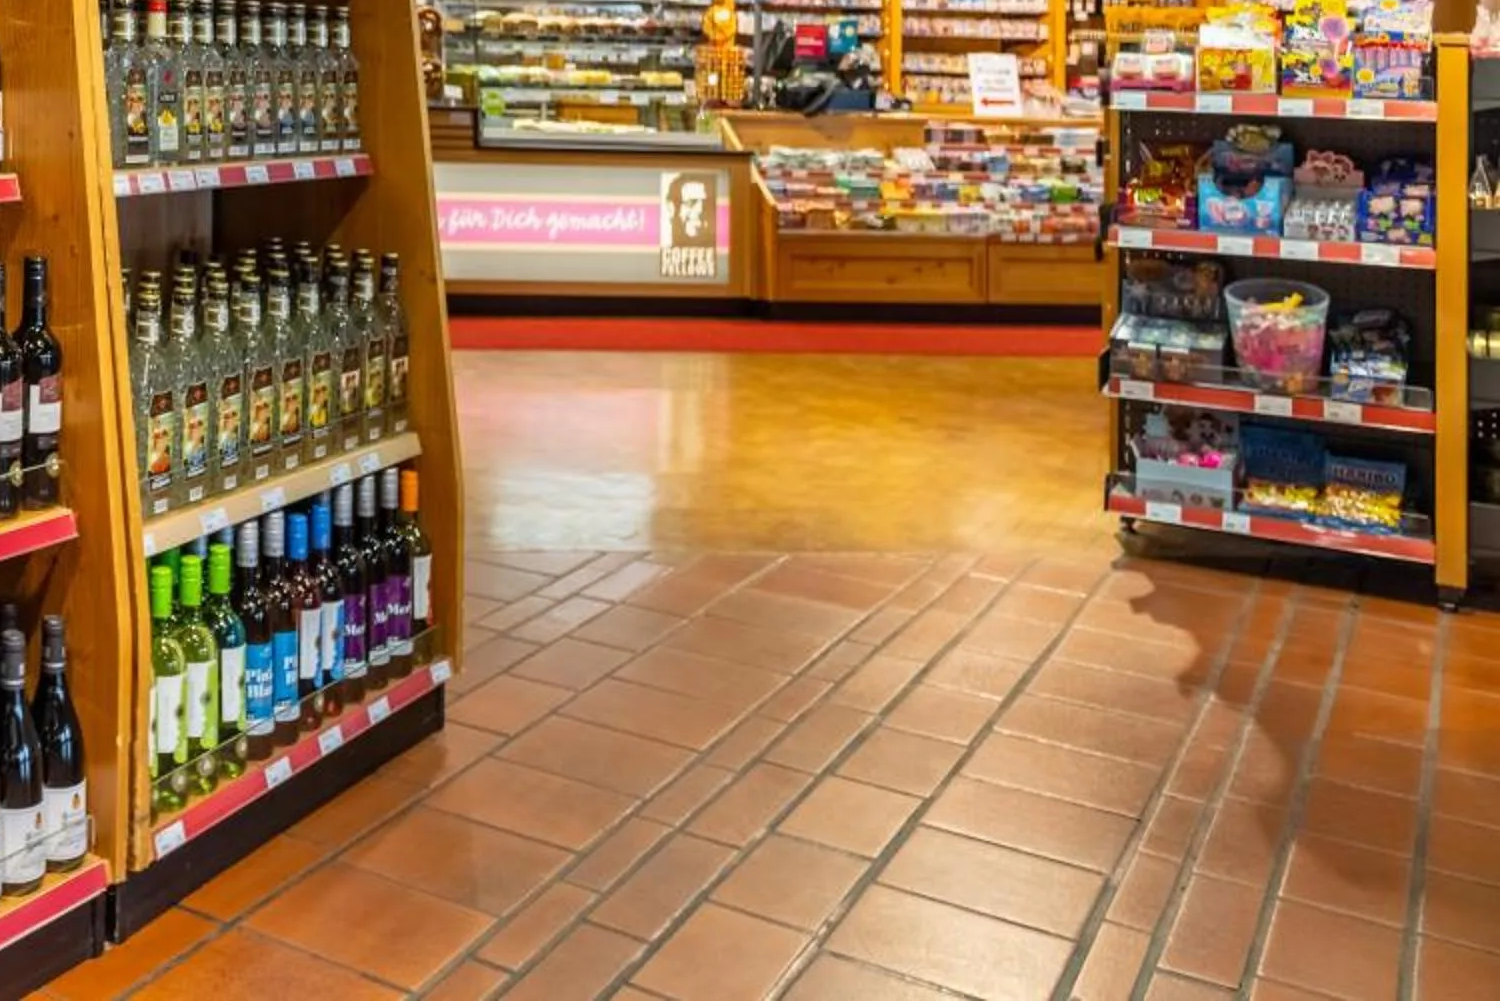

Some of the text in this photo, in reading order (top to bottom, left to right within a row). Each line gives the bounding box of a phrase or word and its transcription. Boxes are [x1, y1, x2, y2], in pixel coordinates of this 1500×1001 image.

[448, 206, 645, 240] für Dich gemacht!
